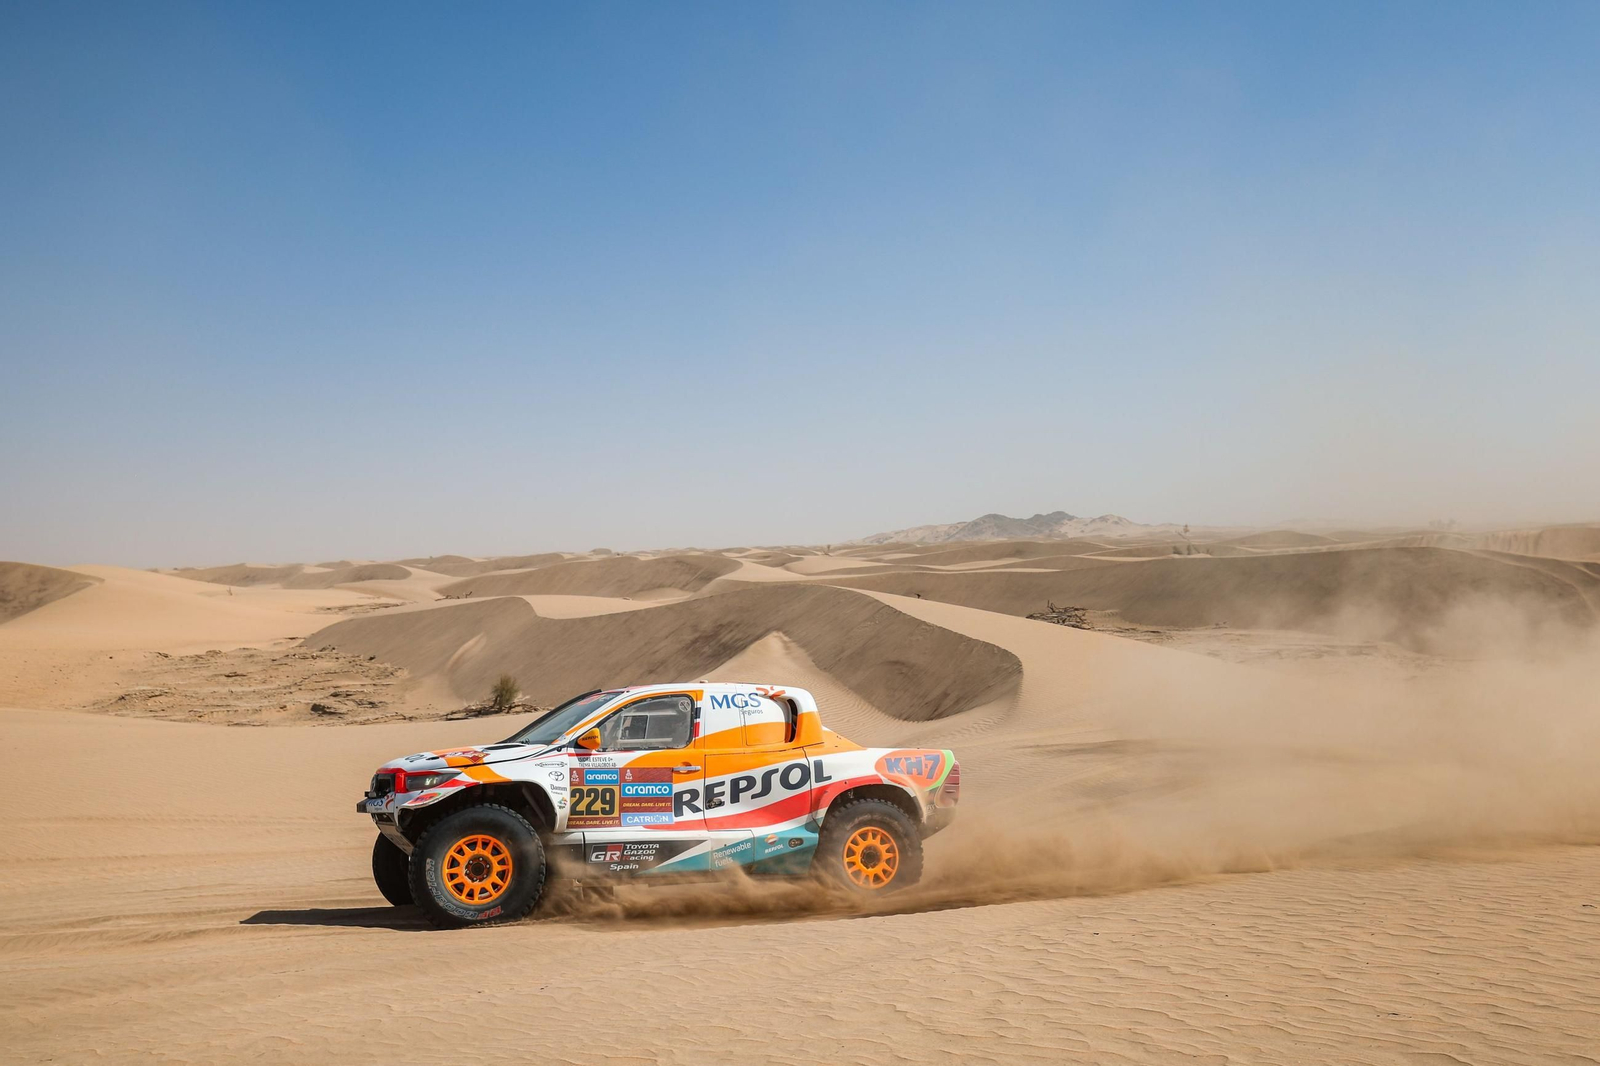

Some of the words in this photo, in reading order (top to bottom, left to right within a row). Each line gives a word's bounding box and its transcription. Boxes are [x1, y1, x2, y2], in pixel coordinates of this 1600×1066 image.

[709, 692, 762, 710] MGS
[740, 708, 764, 716] Seguros
[884, 754, 941, 780] KH-7
[586, 772, 618, 780] aramco
[625, 785, 670, 795] aramco
[673, 759, 832, 818] REPSOL
[570, 787, 616, 816] 229
[626, 815, 669, 823] CATRION
[713, 842, 752, 859] Renewable
[591, 851, 620, 862] GR
[623, 854, 654, 862] Racing
[715, 856, 734, 868] fuels
[610, 863, 639, 871] Spain
